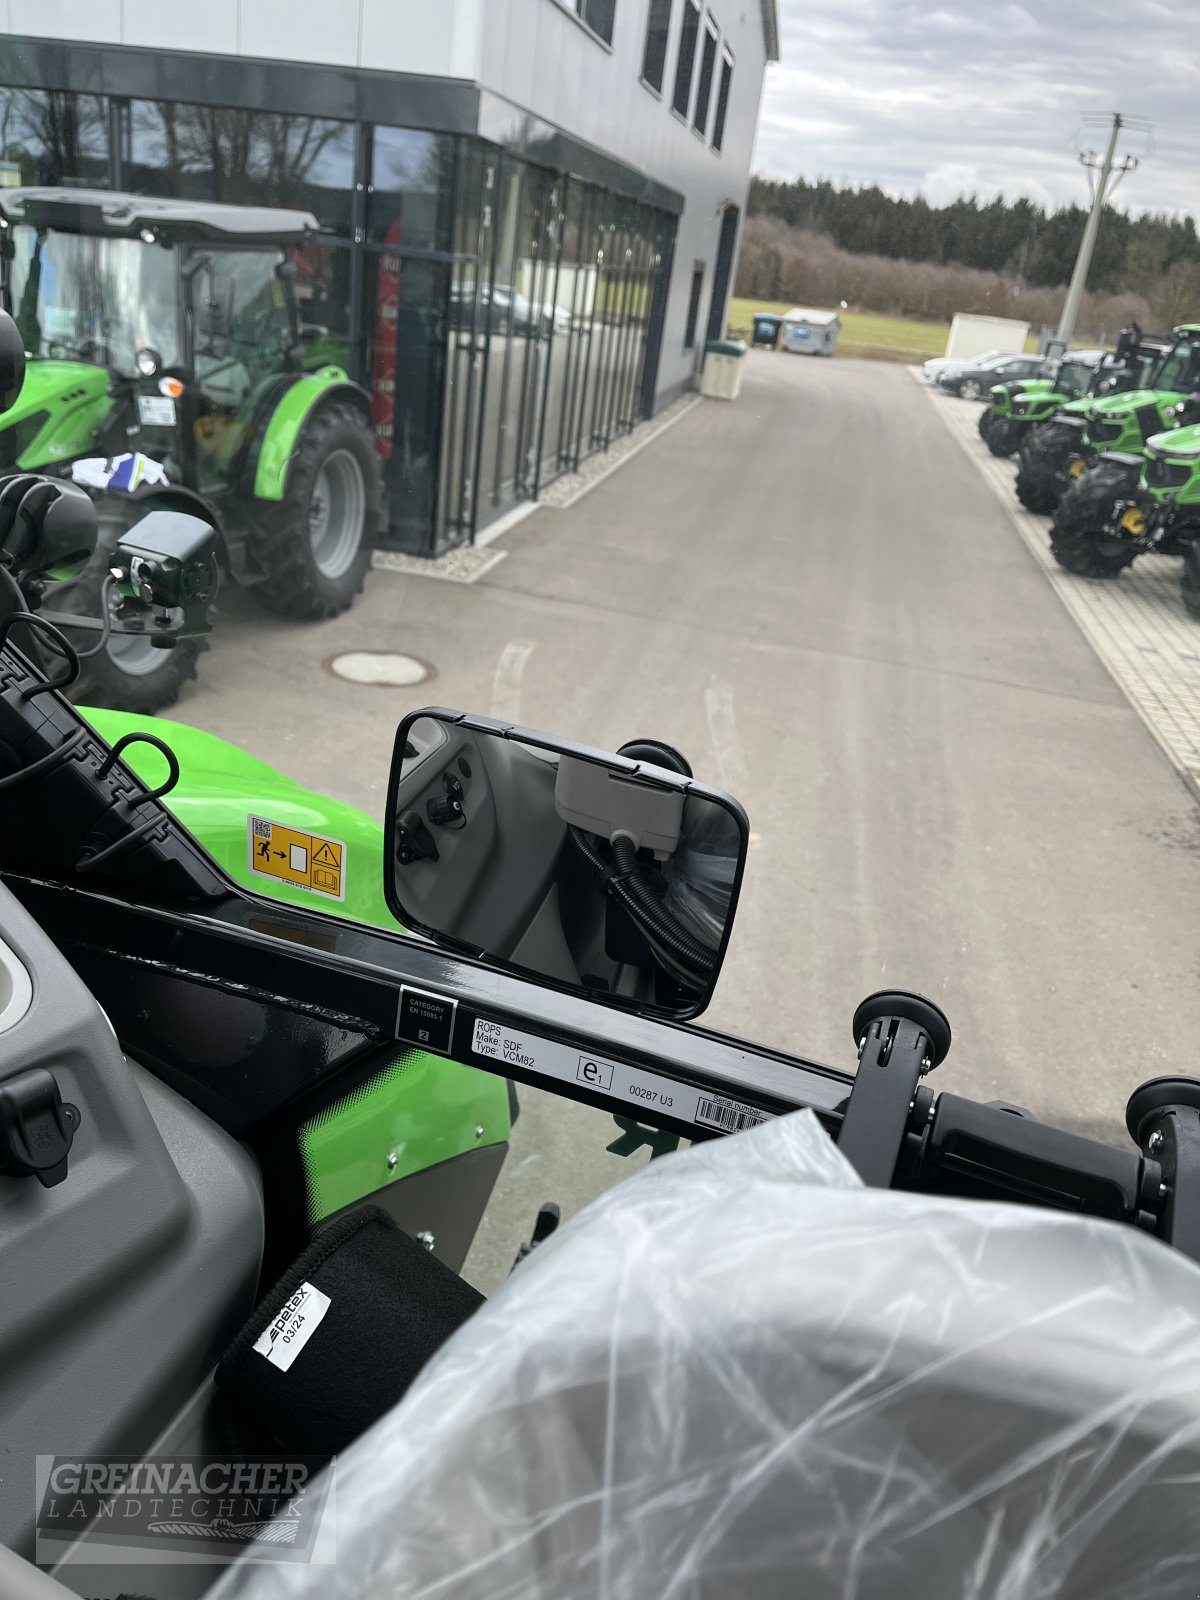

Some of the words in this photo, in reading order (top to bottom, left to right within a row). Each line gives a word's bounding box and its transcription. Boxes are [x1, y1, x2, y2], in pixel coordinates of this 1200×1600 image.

[409, 998, 445, 1014] CATEGORY
[409, 1006, 419, 1014] EN
[477, 1020, 502, 1036] ROPS
[475, 1030, 502, 1047] Make:
[503, 1039, 523, 1052] SDF
[475, 1040, 499, 1056] Type:
[502, 1048, 535, 1068] VCM82
[629, 1085, 658, 1102] 00287
[659, 1094, 674, 1107] U3
[712, 1094, 734, 1108] Serial
[282, 1314, 306, 1344] 03/24
